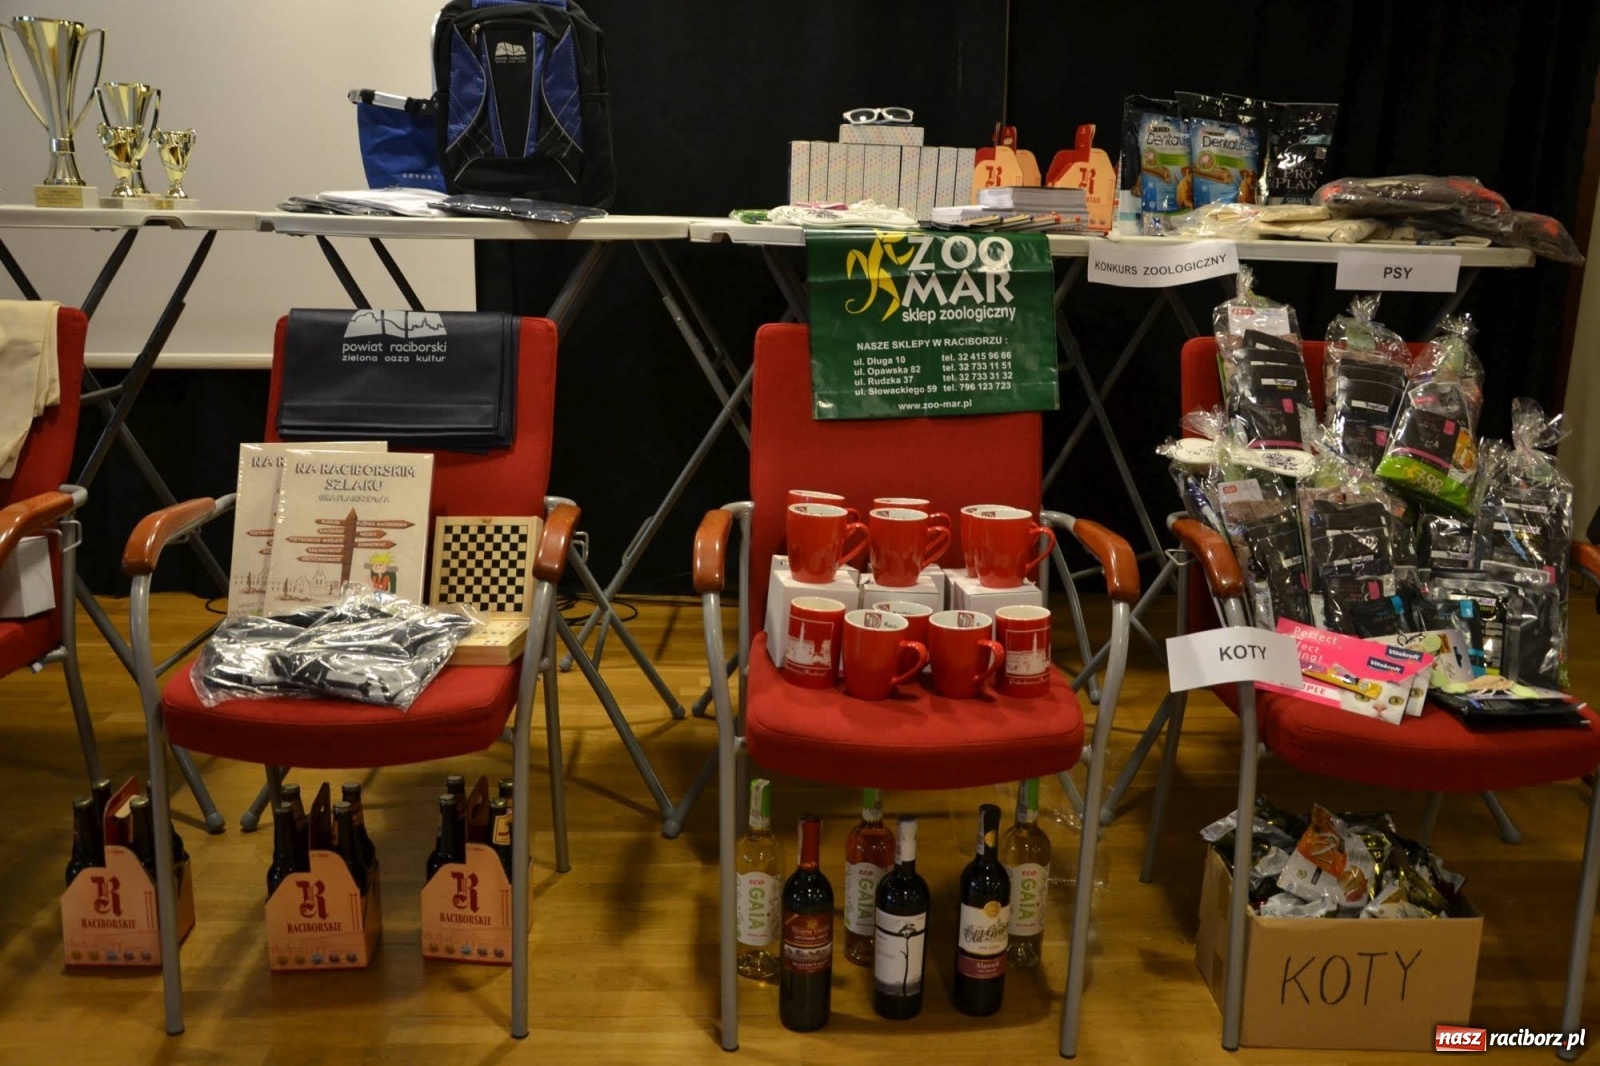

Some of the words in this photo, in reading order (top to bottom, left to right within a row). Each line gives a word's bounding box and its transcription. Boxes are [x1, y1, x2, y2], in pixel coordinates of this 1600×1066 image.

[1202, 135, 1253, 152] Dentalife
[1276, 179, 1317, 190] PLAN
[907, 235, 1014, 270] ZOO
[1094, 260, 1138, 275] KONKURS
[1143, 253, 1227, 276] ZOOLOGICZNY
[1383, 266, 1413, 280] PSY
[901, 268, 1015, 308] MAR
[902, 307, 937, 324] sklep
[940, 305, 1016, 322] zoologiczny
[342, 341, 384, 354] powiat
[390, 341, 447, 352] raciborski
[856, 341, 890, 351] NASZE
[892, 339, 931, 349] SKLEPY
[932, 338, 942, 347] W
[944, 336, 1003, 347] RACIBORZU
[342, 354, 378, 362] zielona
[416, 354, 446, 362] kultur
[853, 358, 865, 366] ul.
[895, 355, 906, 364] 10
[941, 354, 956, 362] tel.
[958, 353, 969, 361] 32
[970, 352, 987, 361] 415
[988, 351, 999, 360] 96
[1001, 351, 1012, 359] 66
[854, 368, 865, 376] ul.
[867, 366, 909, 376] Opawska
[910, 365, 921, 374] 82
[942, 364, 957, 372] tel.
[959, 363, 969, 371] 32
[971, 362, 987, 371] 733
[989, 362, 1000, 370] 11
[1001, 361, 1012, 369] 51
[854, 378, 865, 386] ul.
[868, 376, 901, 385] Rudzka
[903, 375, 914, 384] 37
[942, 374, 957, 382] tel.
[959, 373, 969, 381] 32
[971, 372, 988, 381] 733
[989, 372, 1000, 380] 31
[1002, 371, 1013, 380] 32
[855, 388, 866, 396] ul.
[927, 385, 938, 393] 59
[943, 384, 957, 392] tel.
[960, 383, 976, 391] 796
[978, 382, 993, 390] 123
[995, 381, 1012, 390] 723
[898, 399, 972, 410] www.zoo-mar.pl
[252, 456, 273, 467] NA
[295, 462, 317, 474] NA
[320, 463, 417, 478] RACIBORSKIM
[324, 478, 383, 492] SZLAKU
[1219, 644, 1267, 661] KOTY
[857, 878, 874, 919] GAIA
[1019, 878, 1037, 920] GAIA
[748, 887, 766, 930] GAIA
[81, 919, 136, 929] RACIBORSKIE
[440, 912, 492, 926] RACIBORSKIE
[287, 922, 343, 933] RACIBORSKIE
[1279, 948, 1423, 1006] KOTY
